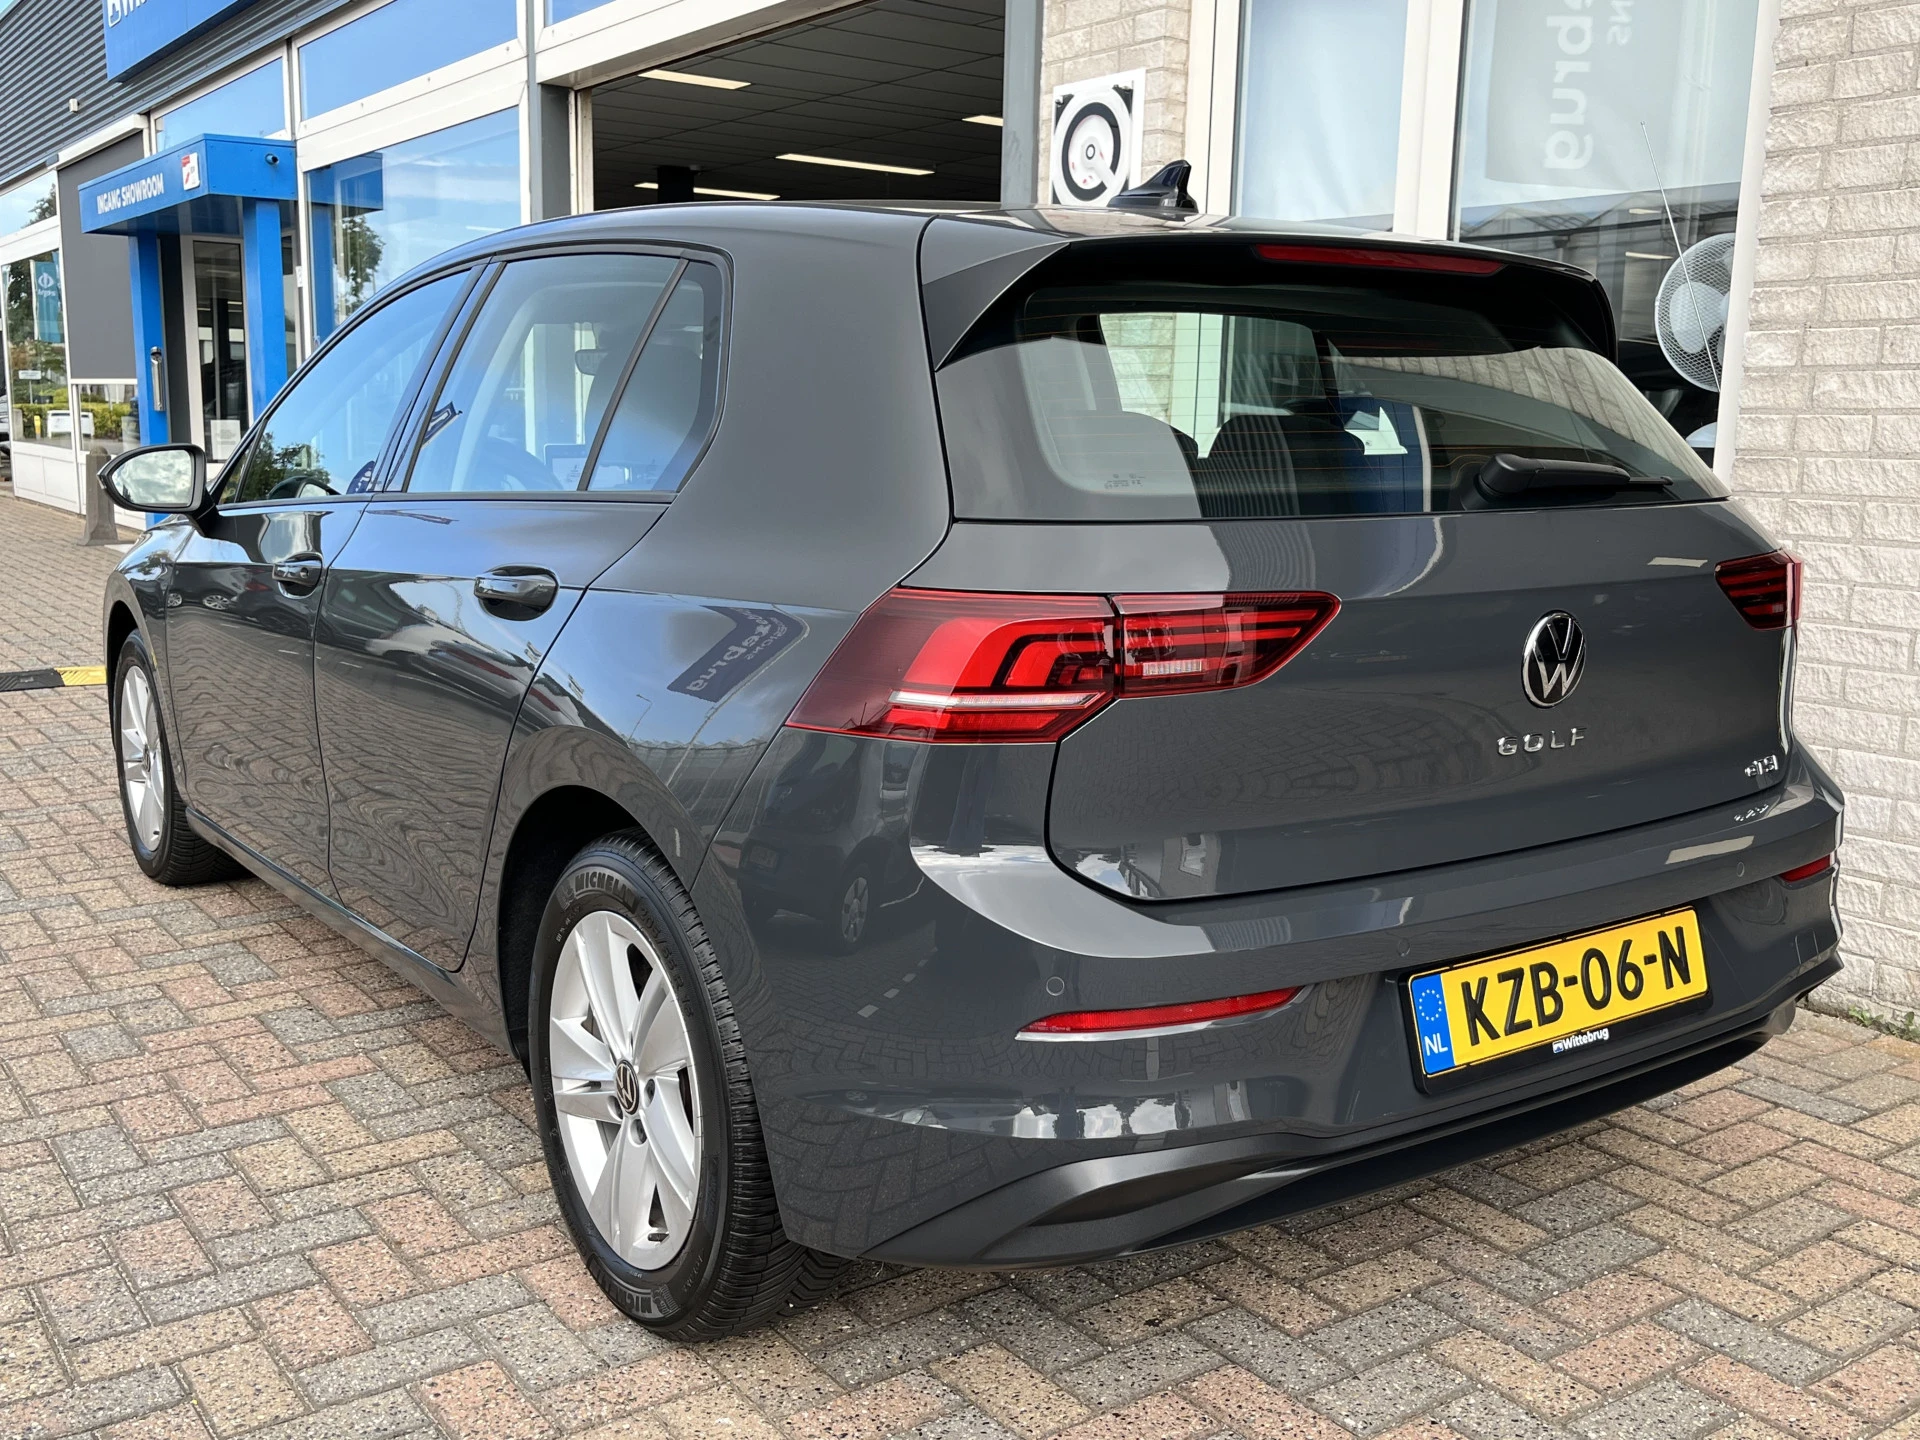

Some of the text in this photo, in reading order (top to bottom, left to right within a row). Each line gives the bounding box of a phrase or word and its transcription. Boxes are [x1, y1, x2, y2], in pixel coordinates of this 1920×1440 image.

[97, 172, 165, 215] INGANG SHOWROOM
[1497, 727, 1588, 756] GOLF
[574, 871, 640, 915] MICHELIN
[1461, 926, 1692, 1046] KZB-06-N
[1424, 1031, 1449, 1056] NL
[1562, 1027, 1610, 1050] Wittebrug
